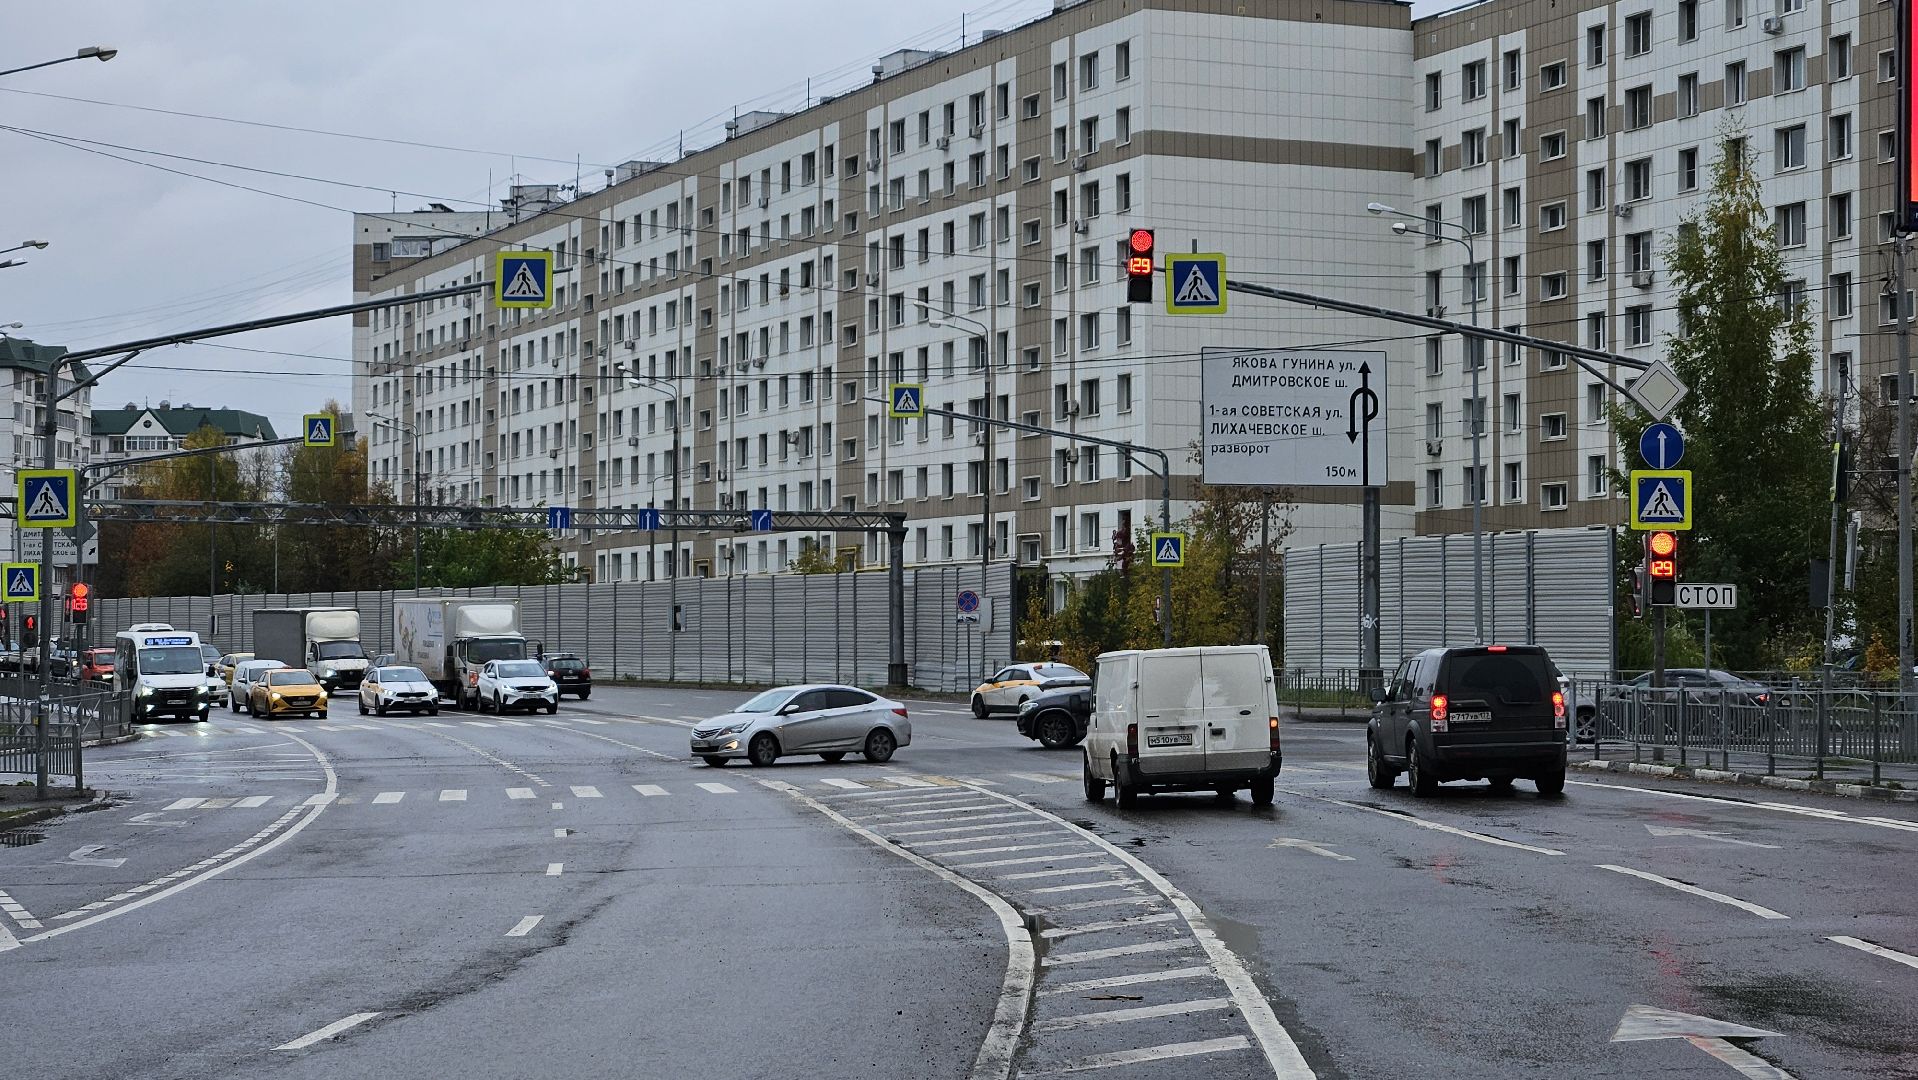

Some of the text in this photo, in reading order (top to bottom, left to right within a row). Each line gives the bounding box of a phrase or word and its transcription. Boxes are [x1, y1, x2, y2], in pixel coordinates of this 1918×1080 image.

[1130, 258, 1150, 273] 129
[1232, 357, 1356, 373] ЯКОВА ГУНИНА ул.
[1231, 375, 1348, 388] ДМИТРОВСКОЕ ш.
[1209, 404, 1343, 421] 1-ая СОВЕТСКАЯ ул.
[1210, 422, 1325, 436] ЛИХАЧЕВСКОЕ ш.
[1211, 444, 1270, 457] разворот
[37, 541, 75, 549] СТСКАЯ
[1652, 561, 1673, 577] 129
[1680, 586, 1733, 605] СТОП
